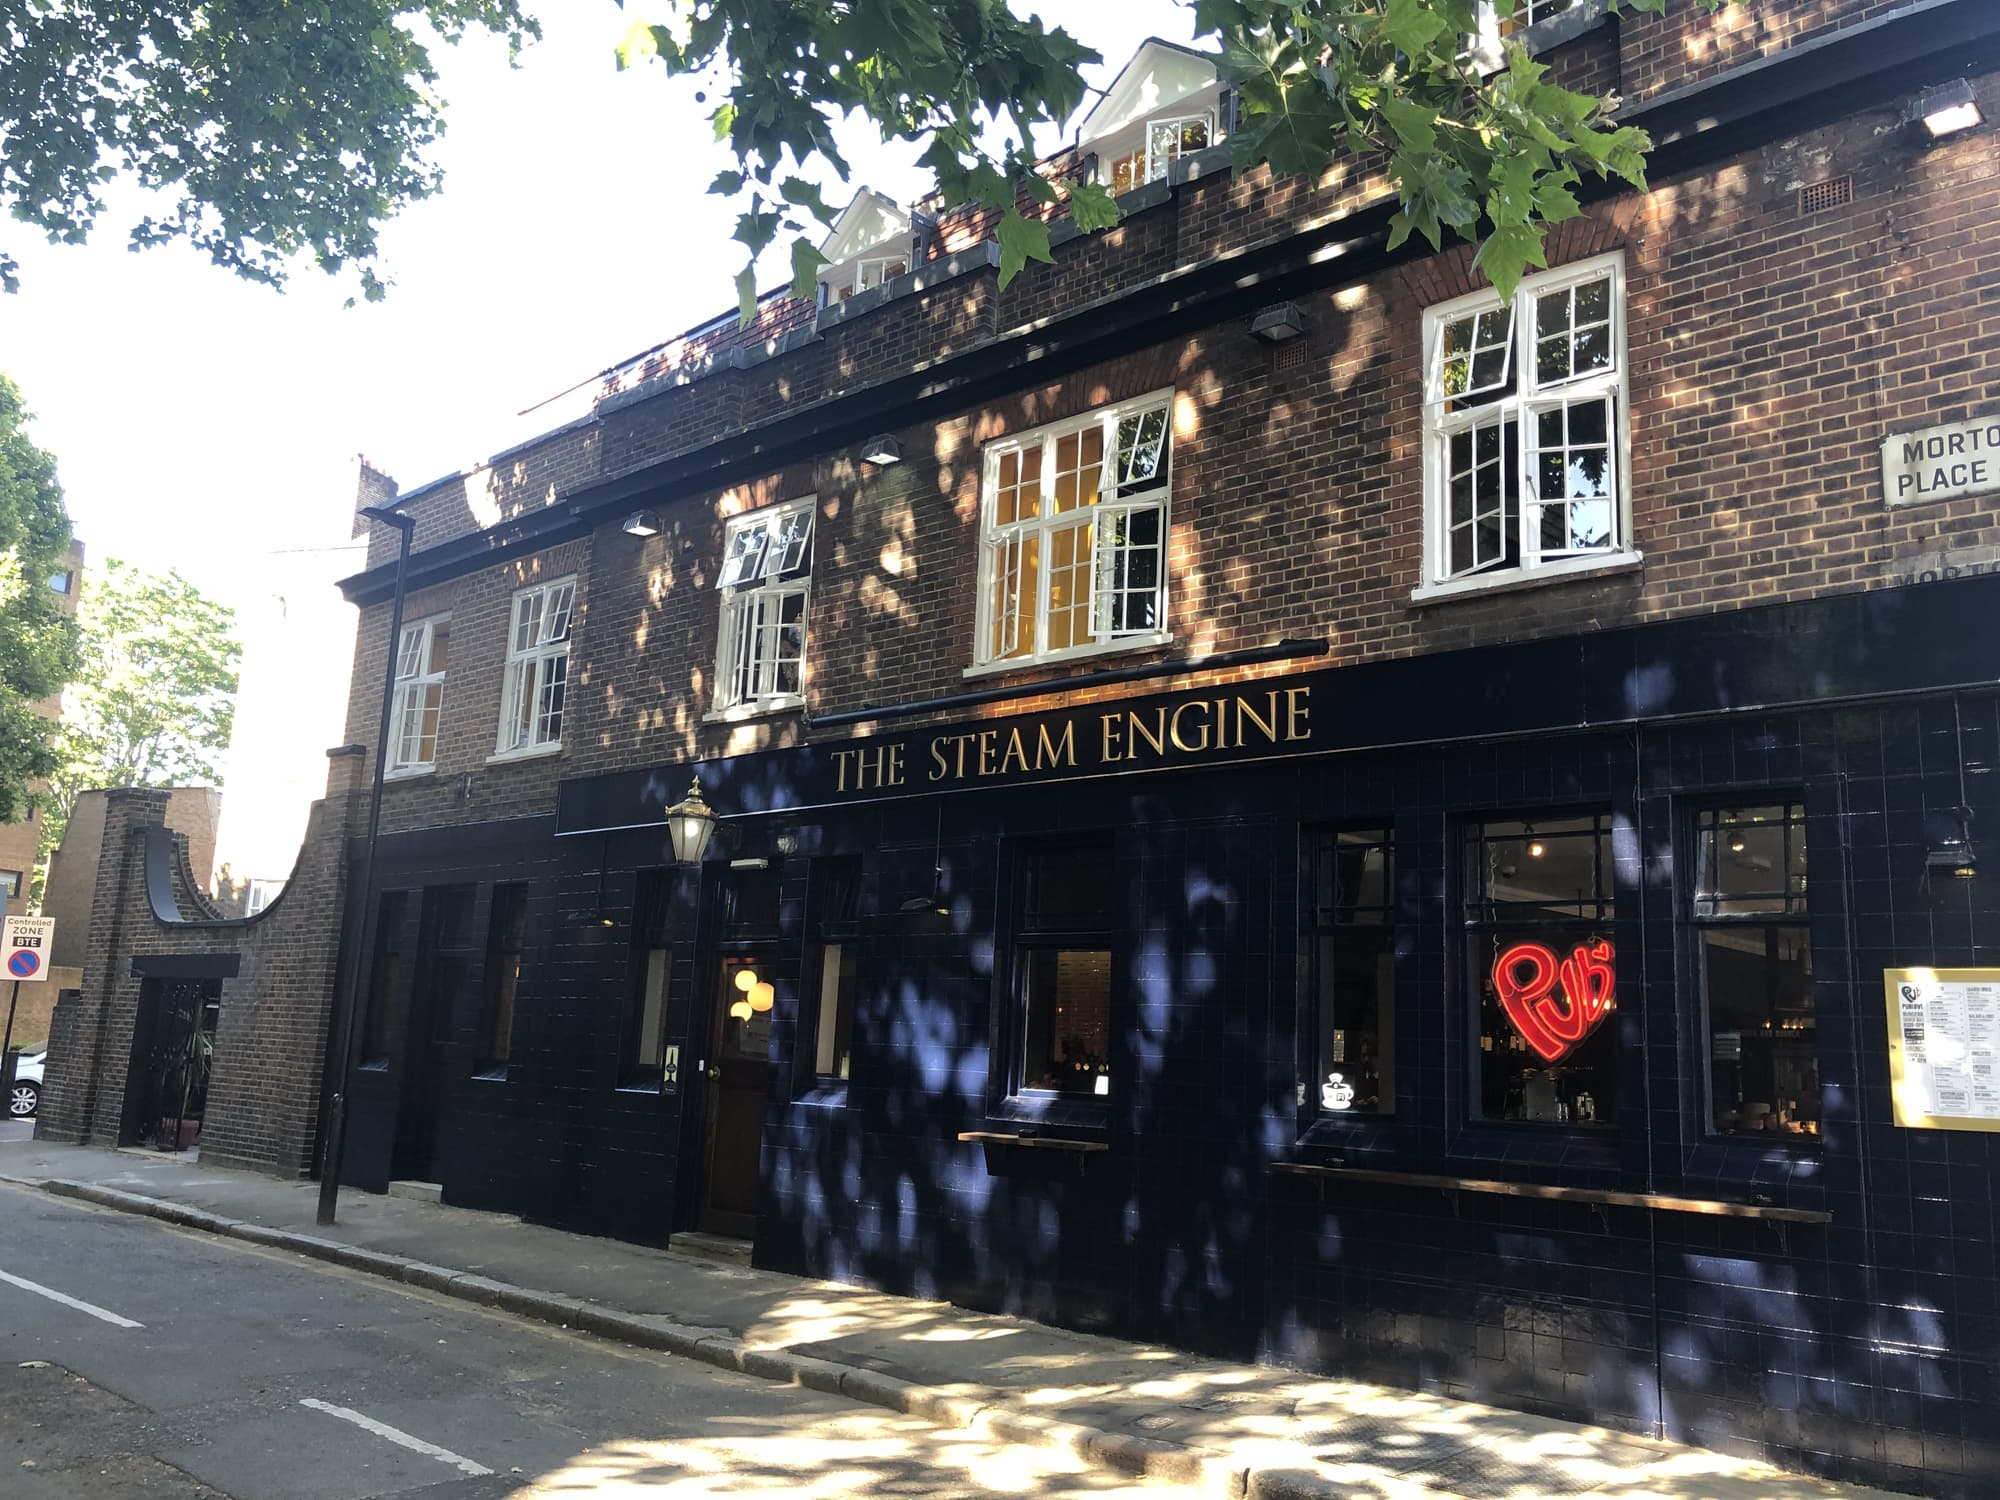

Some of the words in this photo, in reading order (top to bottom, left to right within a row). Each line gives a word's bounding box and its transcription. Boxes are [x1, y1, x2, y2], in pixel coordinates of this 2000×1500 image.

[1903, 425, 2000, 464] MORTO
[1897, 460, 1988, 496] PLACE
[831, 743, 905, 792] THE
[928, 718, 1077, 781] STEAM
[1099, 687, 1312, 763] ENGINE
[8, 918, 52, 926] Controlled
[13, 926, 44, 935] ZONE
[17, 937, 38, 946] BTE
